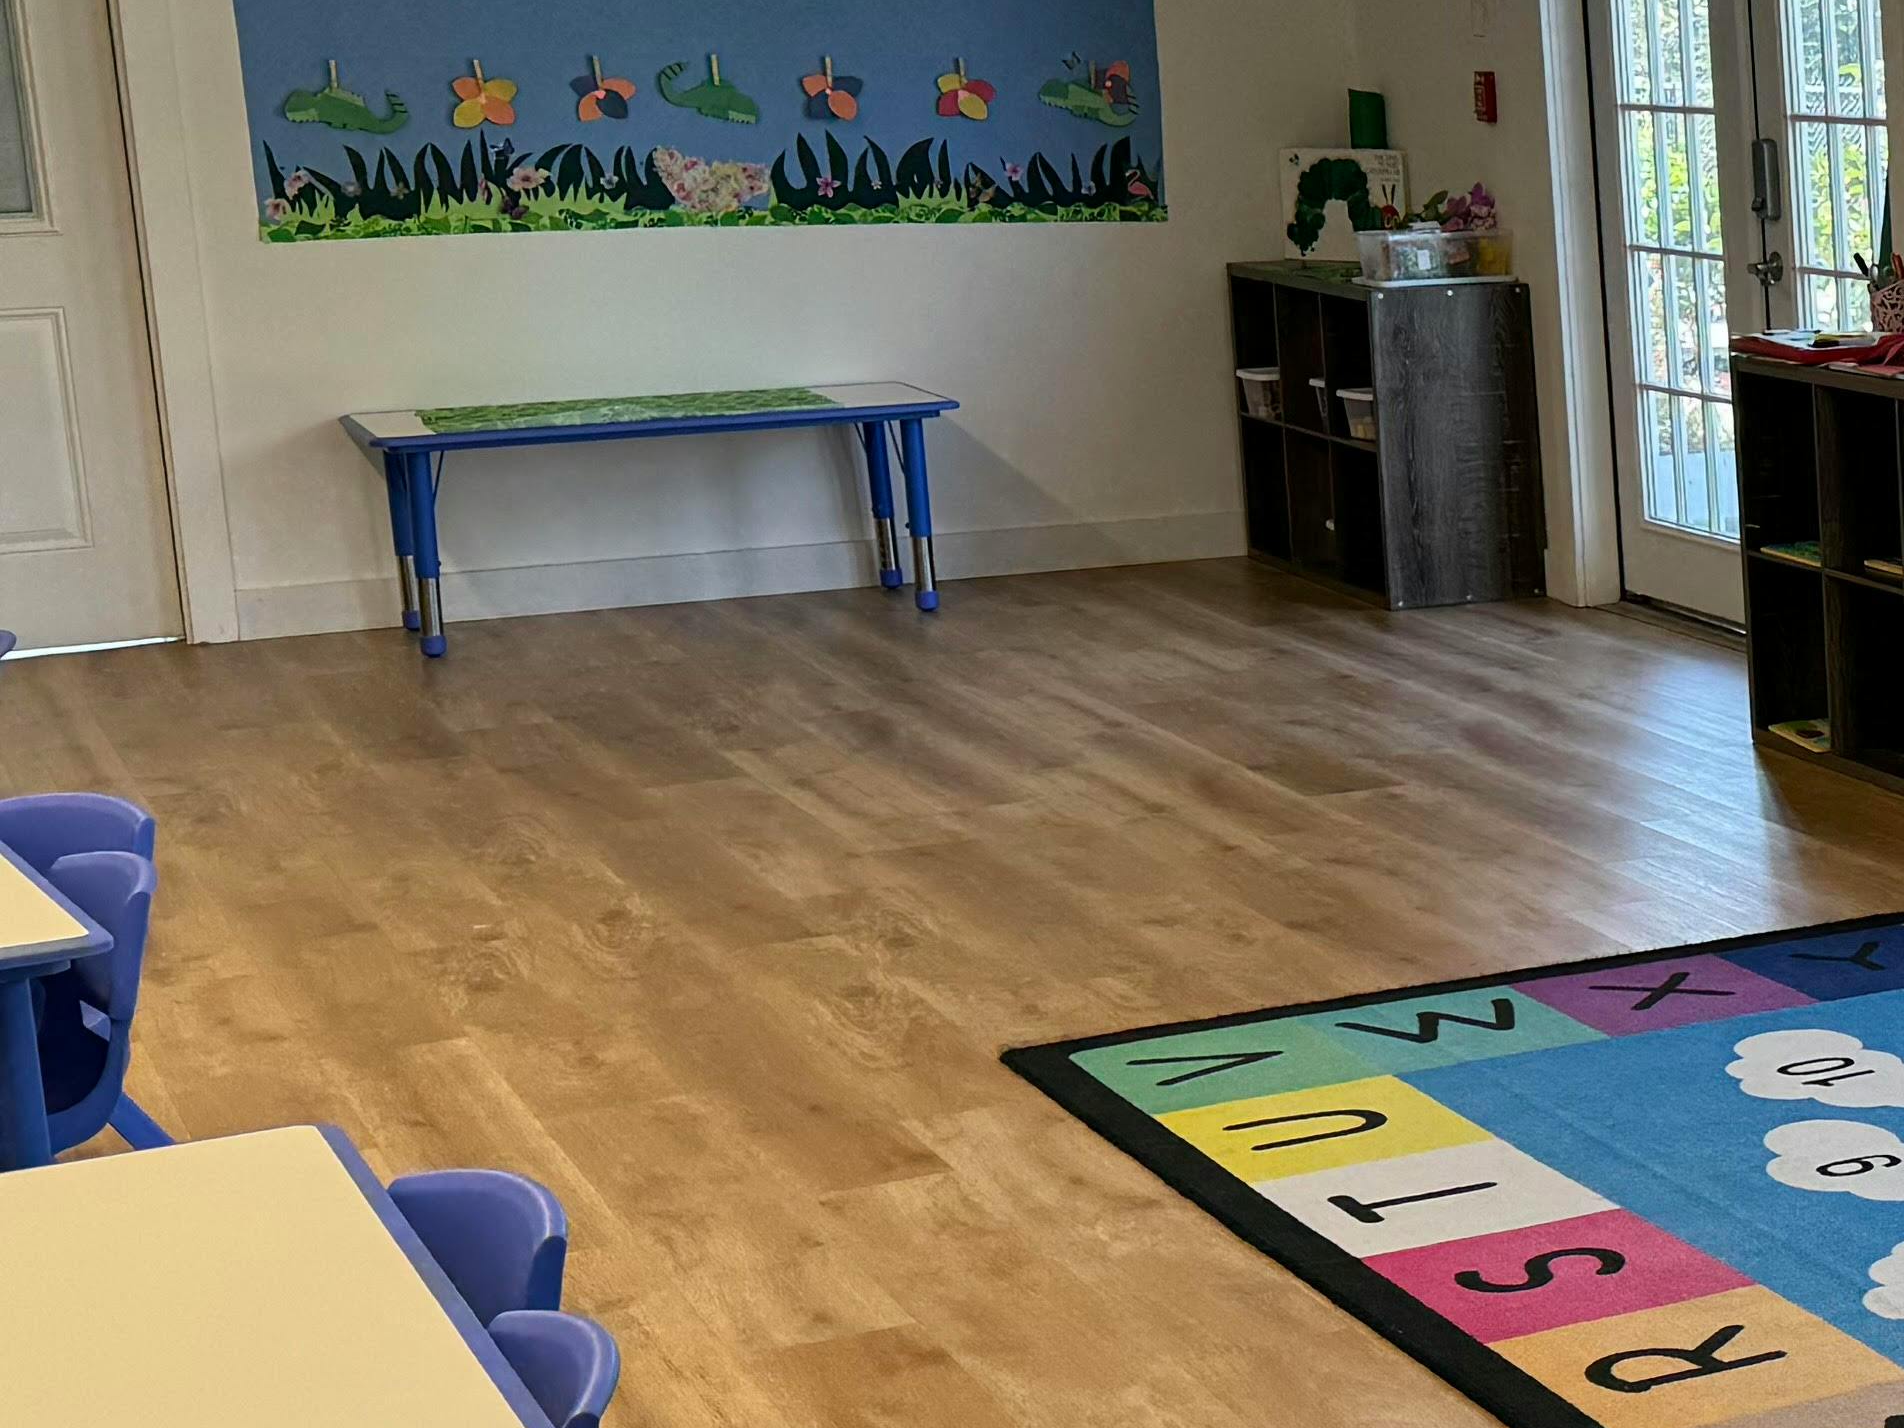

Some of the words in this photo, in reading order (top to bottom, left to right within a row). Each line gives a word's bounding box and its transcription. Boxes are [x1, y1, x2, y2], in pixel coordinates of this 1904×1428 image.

[1789, 940, 1885, 971] Y
[1588, 971, 1737, 1012] X
[1335, 997, 1516, 1044] W
[1125, 1048, 1284, 1087] V
[1775, 1054, 1876, 1088] 10
[1222, 1108, 1389, 1152] U
[1327, 1180, 1499, 1224] T
[1454, 1246, 1626, 1293] S
[1584, 1324, 1789, 1394] R
